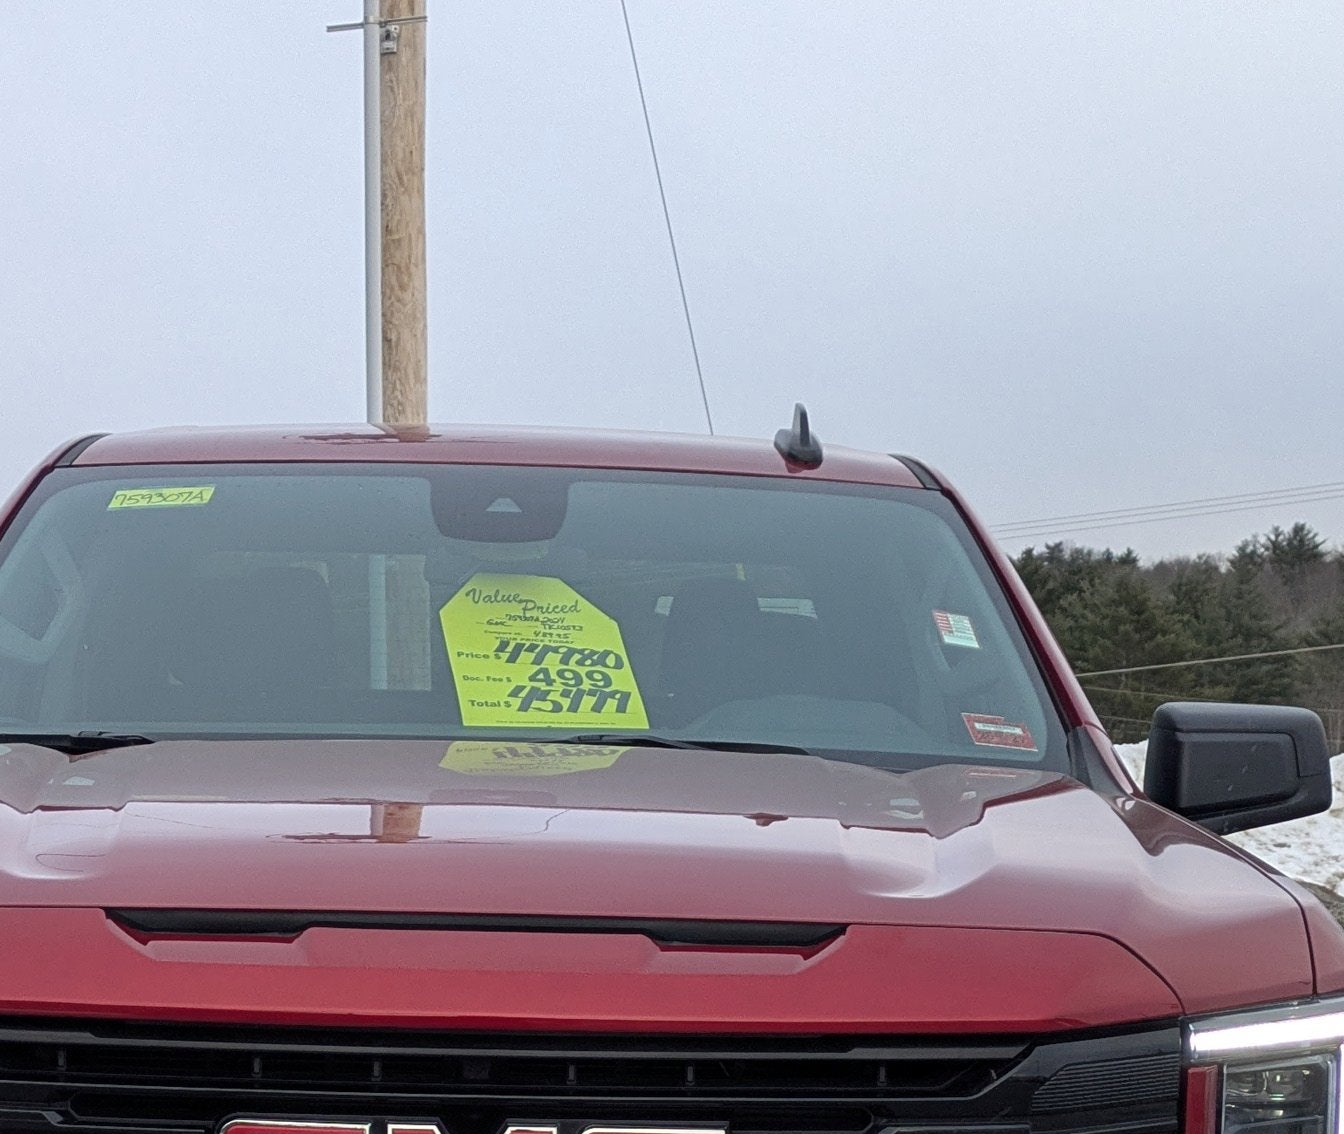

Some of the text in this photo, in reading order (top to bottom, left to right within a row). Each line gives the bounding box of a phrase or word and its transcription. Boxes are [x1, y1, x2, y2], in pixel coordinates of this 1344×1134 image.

[114, 489, 204, 506] 759307A
[465, 588, 523, 604] Value
[521, 600, 581, 617] Priced
[457, 639, 625, 670] Price $ 44980
[462, 674, 483, 682] Doc.
[528, 667, 613, 688] 499
[470, 699, 503, 708] Total
[504, 699, 512, 708] $
